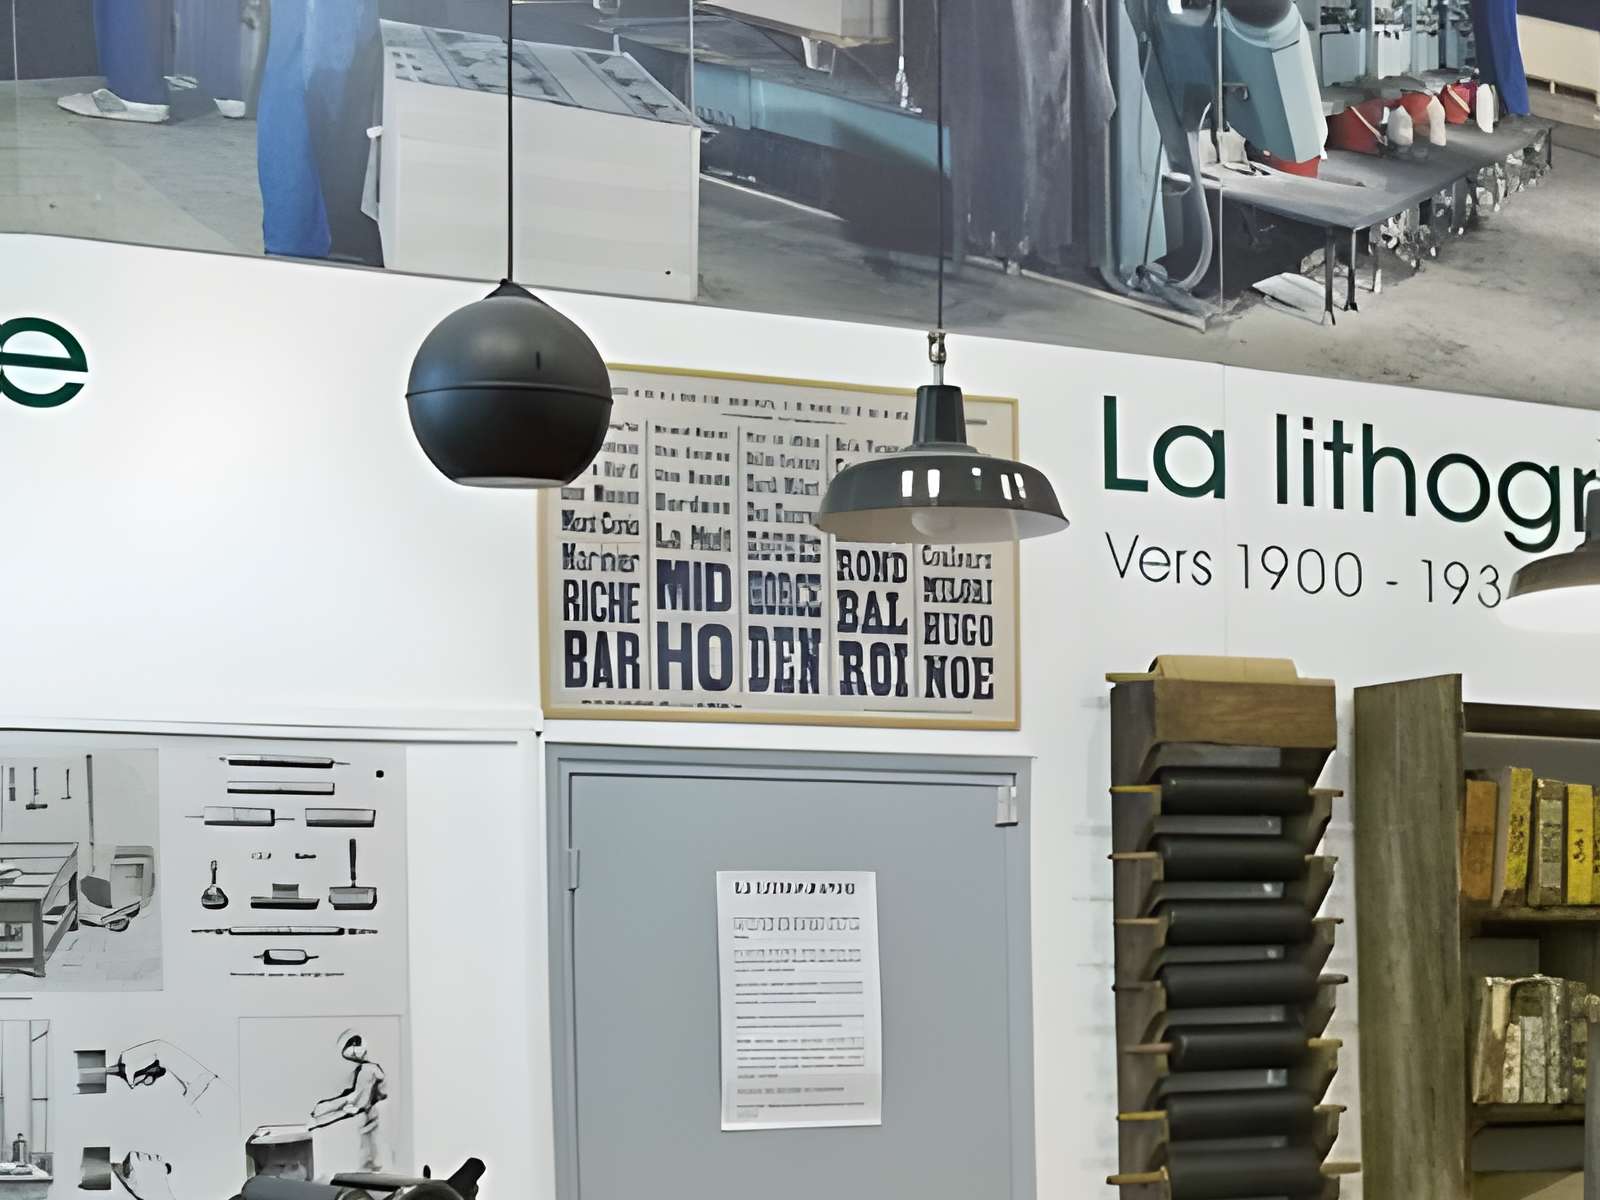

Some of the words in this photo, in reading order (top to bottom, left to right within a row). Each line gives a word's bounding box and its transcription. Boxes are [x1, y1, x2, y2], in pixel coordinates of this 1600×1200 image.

[1103, 395, 1226, 499] La
[657, 558, 732, 612] MID
[836, 549, 908, 583] ROND
[1105, 531, 1212, 587] Vers
[1236, 543, 1362, 598] 1900
[1421, 559, 1502, 609] 193
[563, 579, 640, 624] RICHE
[837, 589, 909, 636] BAL
[924, 611, 993, 647] HUGO
[564, 629, 640, 689] BAR
[657, 621, 733, 692] HO
[748, 626, 822, 694] DEN
[838, 640, 909, 698] ROI
[923, 655, 994, 700] NOE
